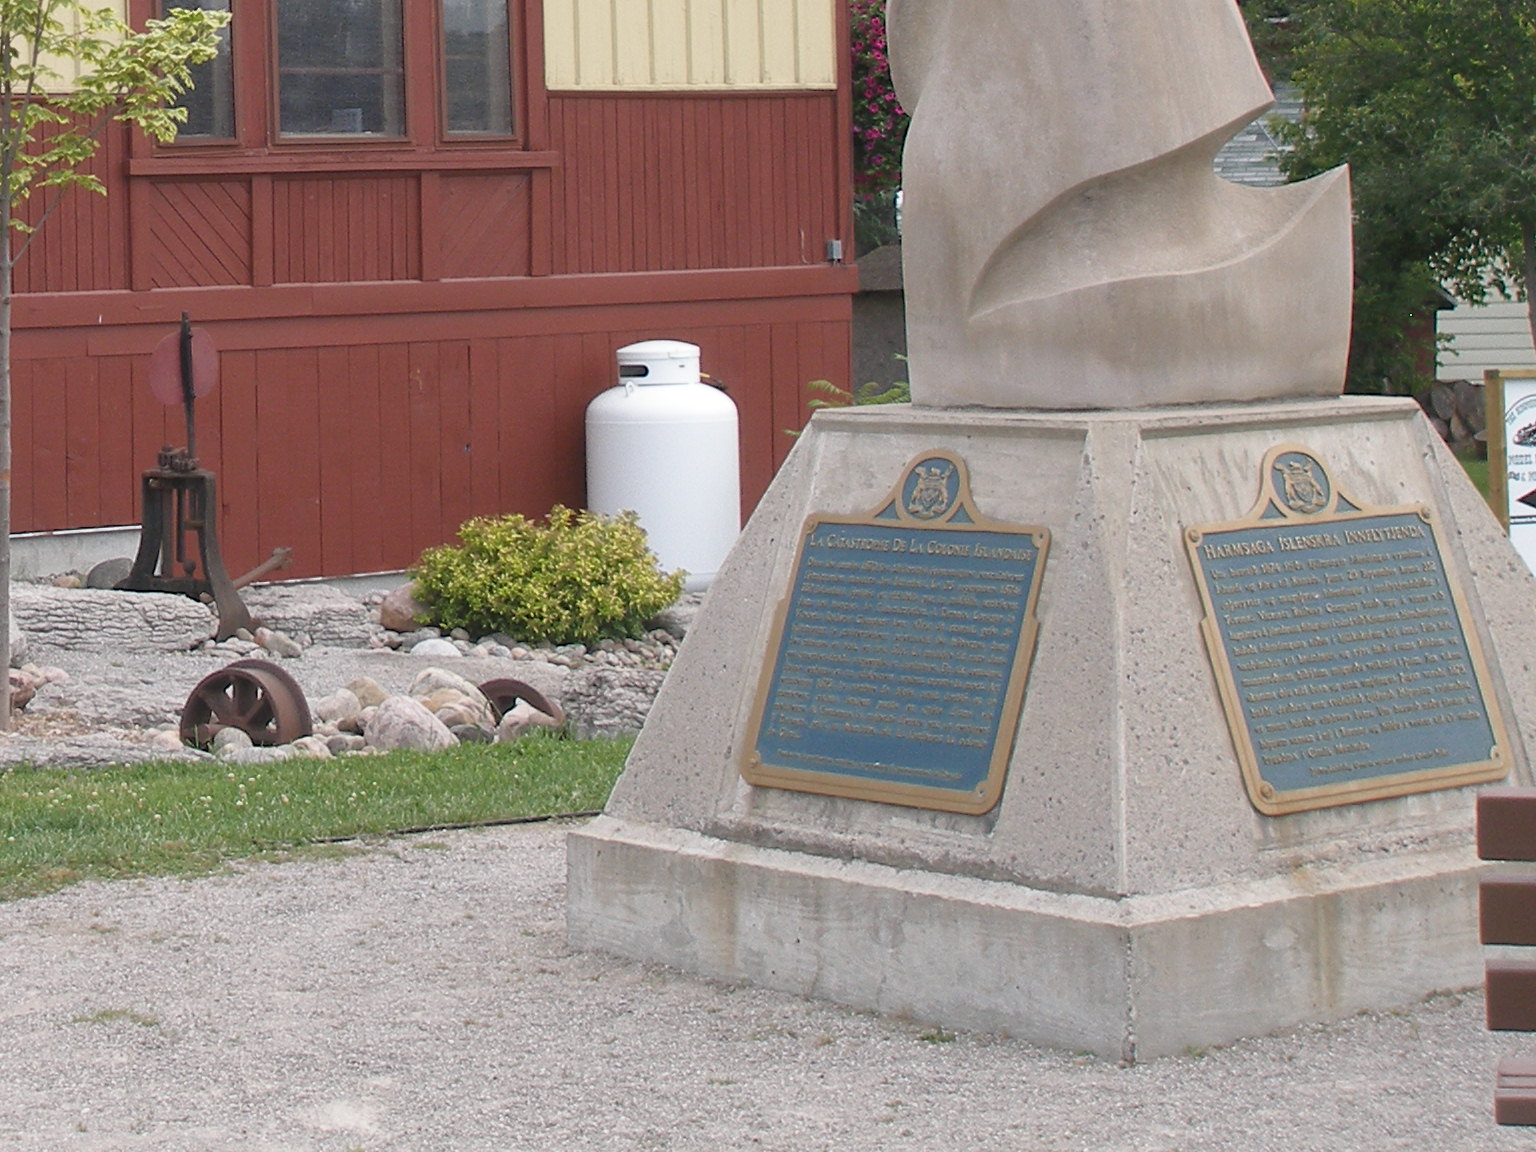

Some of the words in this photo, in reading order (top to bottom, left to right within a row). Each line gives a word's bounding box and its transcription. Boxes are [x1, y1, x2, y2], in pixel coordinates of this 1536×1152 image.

[810, 534, 824, 547] LA
[827, 534, 890, 554] CATASTROPHE
[892, 538, 906, 553] DE
[909, 538, 924, 554] LA
[927, 540, 970, 557] COLONIE
[974, 543, 1034, 562] ISLANDAISE
[1204, 539, 1274, 561] HARMSAGA
